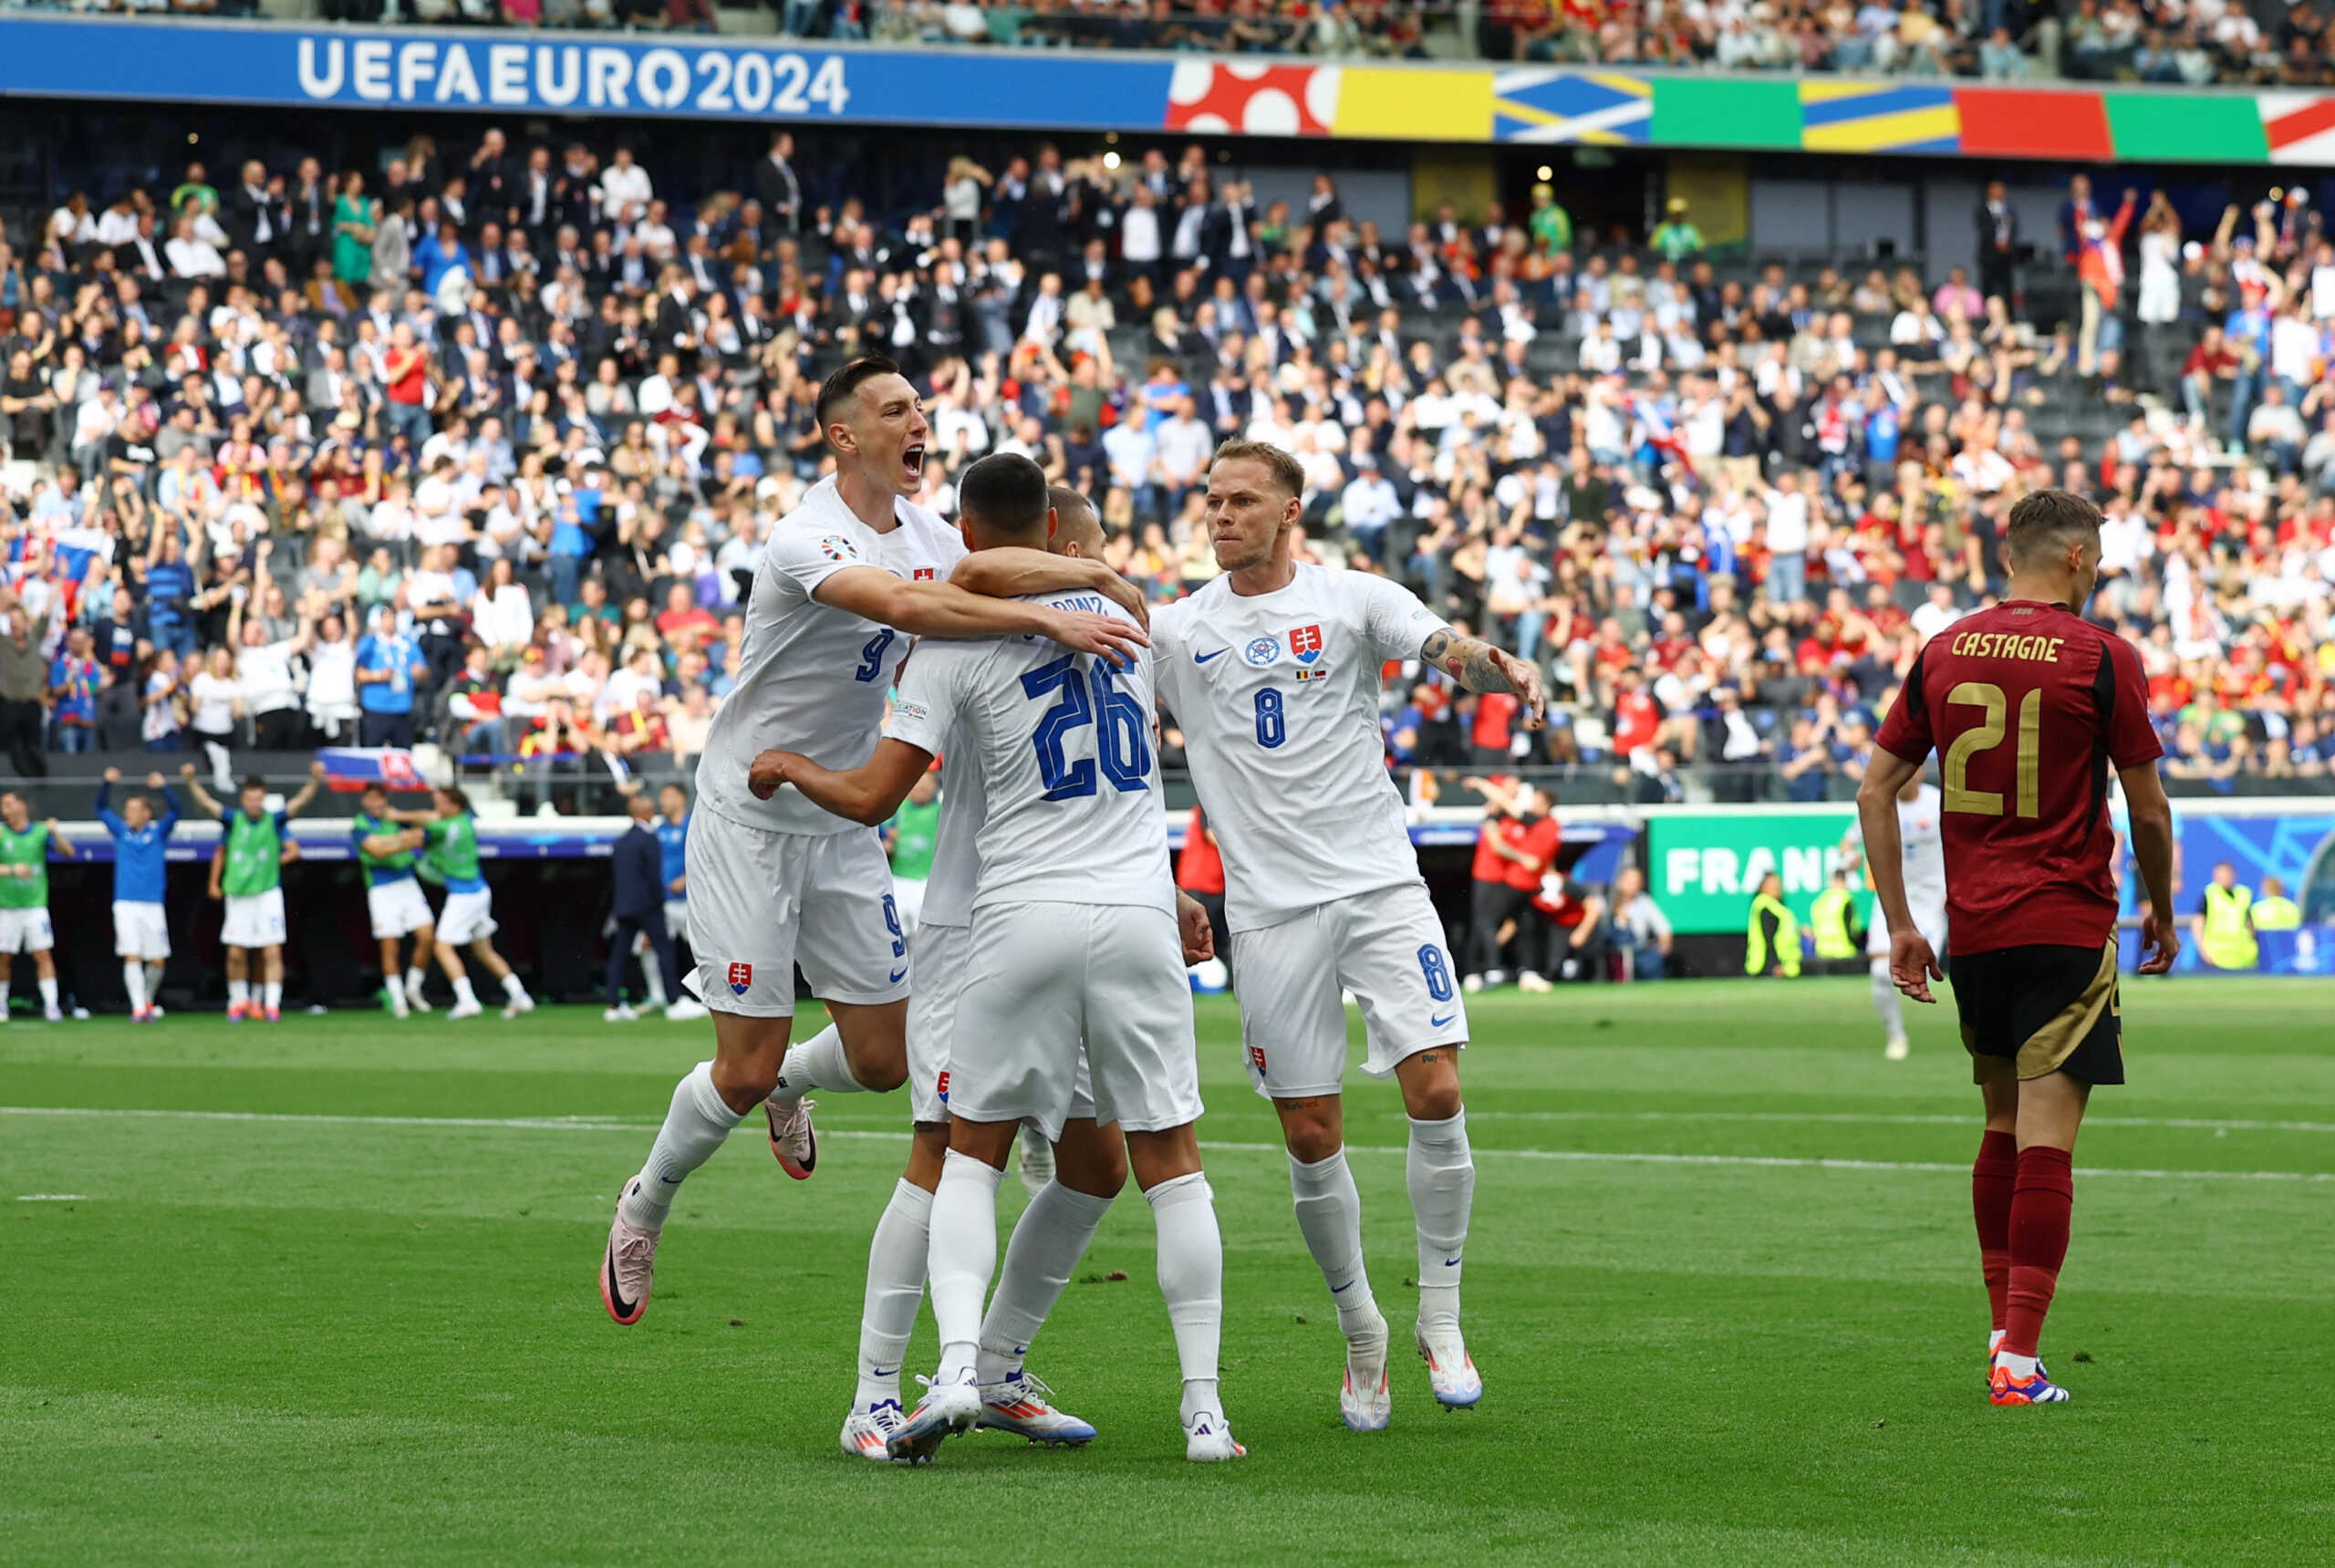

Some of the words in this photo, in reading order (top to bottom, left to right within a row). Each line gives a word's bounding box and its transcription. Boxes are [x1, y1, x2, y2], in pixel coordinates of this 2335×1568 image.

[856, 628, 895, 682] 9
[1951, 631, 2065, 663] CASTAGNE
[1020, 648, 1151, 802] 26
[1254, 687, 1286, 748] 8
[1944, 681, 2042, 818] 21
[882, 893, 905, 958] 9
[1417, 943, 1454, 1002] 8
